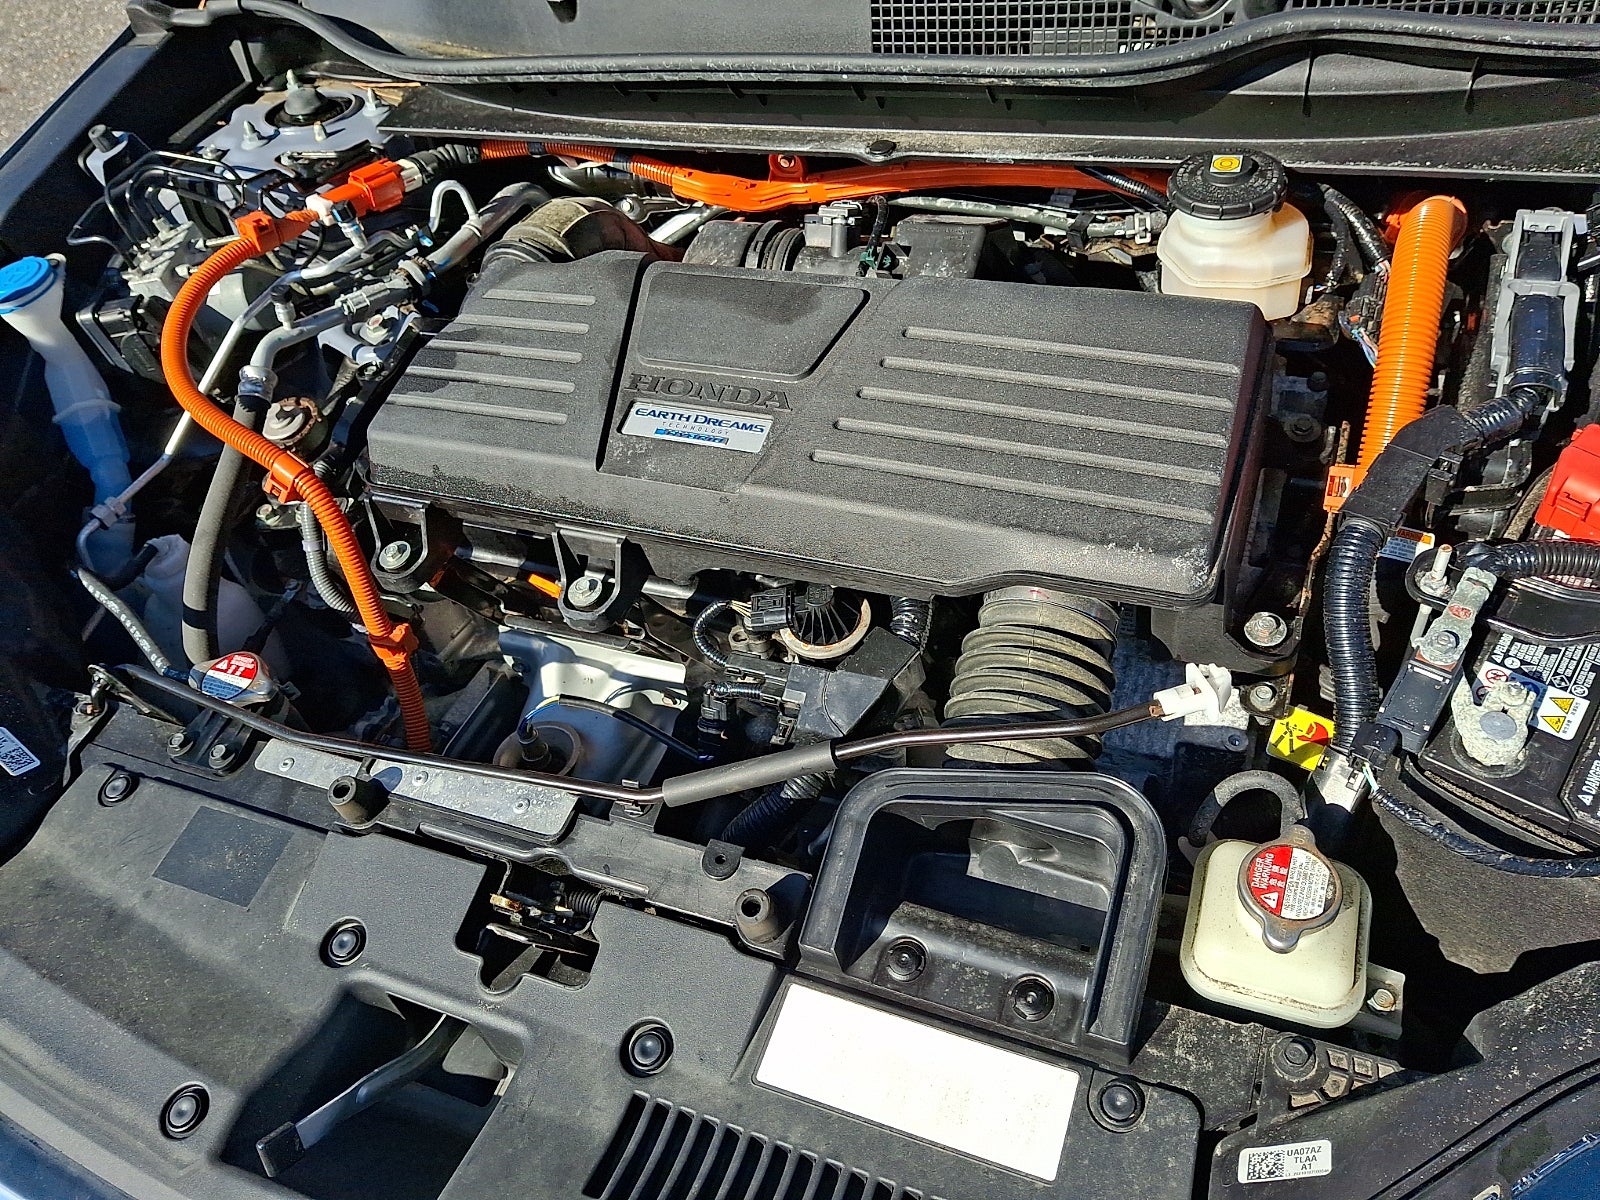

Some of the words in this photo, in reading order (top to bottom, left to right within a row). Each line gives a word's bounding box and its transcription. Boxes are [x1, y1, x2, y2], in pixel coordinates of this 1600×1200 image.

[624, 373, 793, 411] HONDA
[635, 408, 690, 423] EARTH
[693, 414, 766, 434] DREAMS
[662, 421, 729, 435] TECHNOLOGY
[1251, 858, 1265, 888] DANGER
[1259, 852, 1274, 889] WARNUNG
[1286, 1145, 1322, 1156] UA07AZ
[1294, 1155, 1317, 1163] TLAA
